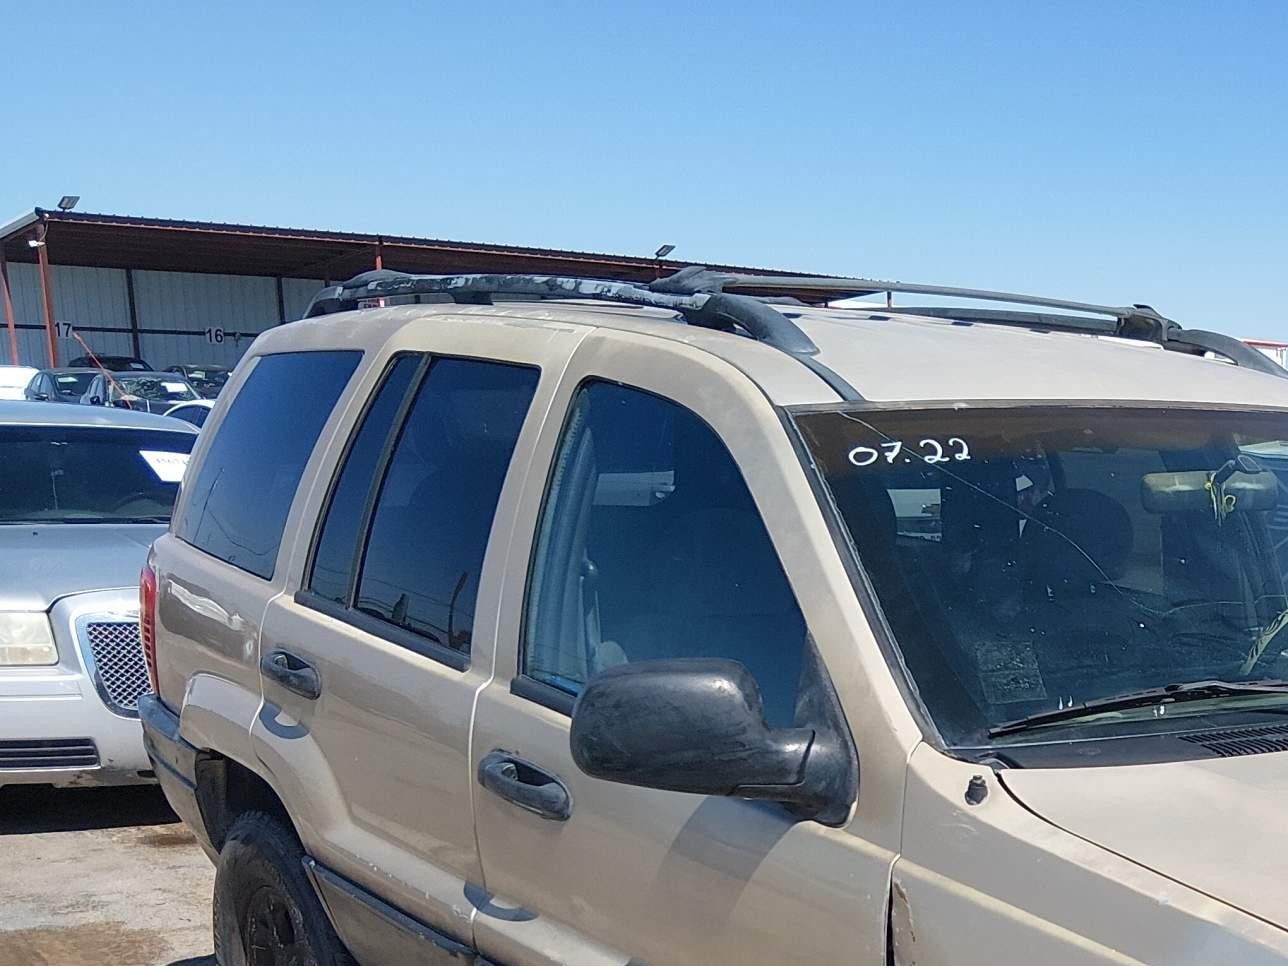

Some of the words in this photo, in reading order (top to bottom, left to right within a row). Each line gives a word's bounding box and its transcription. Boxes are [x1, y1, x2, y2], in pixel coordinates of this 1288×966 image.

[54, 322, 72, 338] 17
[206, 328, 224, 344] 16
[848, 437, 972, 467] 07.22
